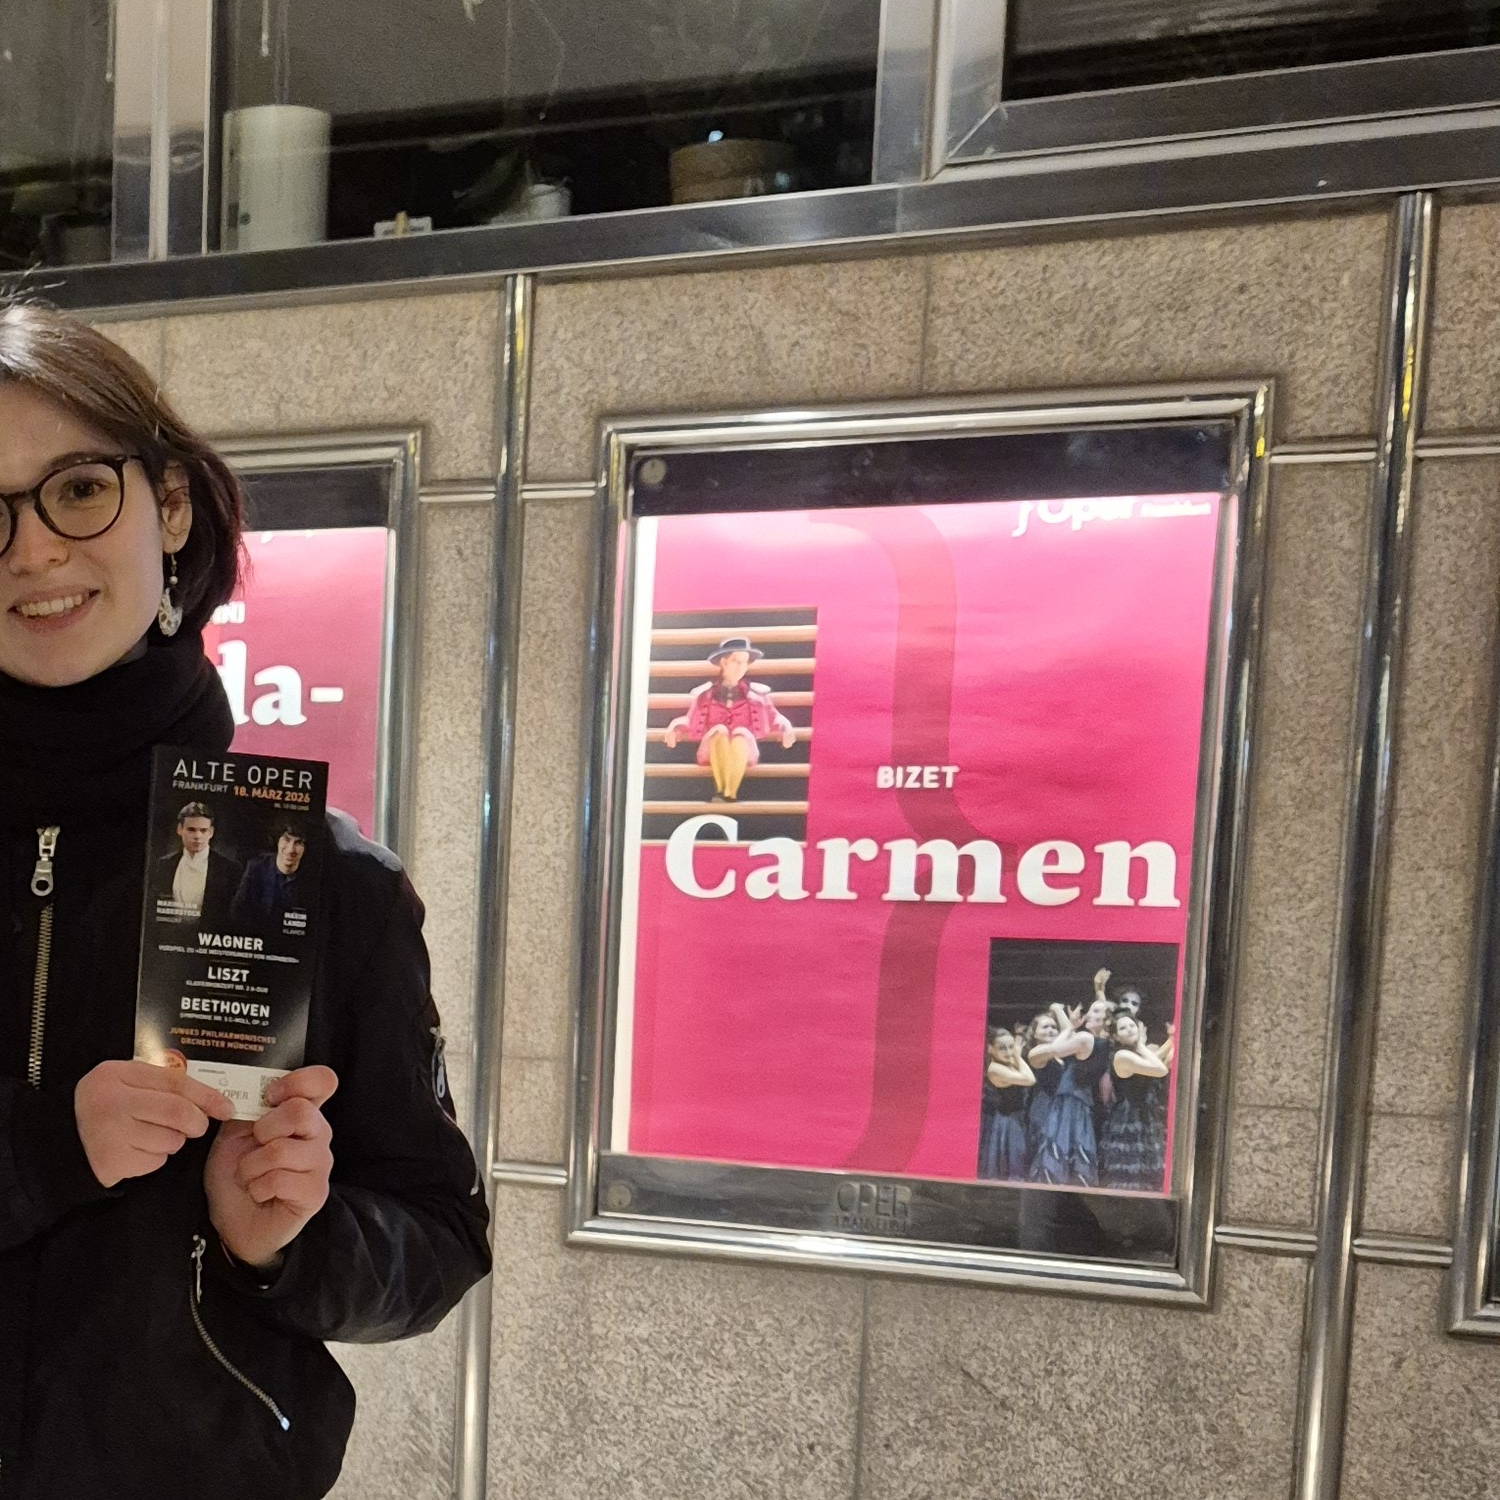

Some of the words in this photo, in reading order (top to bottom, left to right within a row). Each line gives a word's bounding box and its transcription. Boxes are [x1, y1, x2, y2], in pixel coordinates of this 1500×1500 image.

[173, 759, 236, 782] ALTE
[247, 766, 313, 790] OPER
[876, 765, 960, 791] BIZET
[172, 780, 229, 793] FRANKFURT
[234, 785, 249, 798] 18.
[252, 787, 283, 801] MÄRZ
[284, 791, 310, 803] 2026
[664, 814, 1182, 909] Carmen
[198, 932, 264, 951] WAGNER
[207, 966, 250, 982] LISZT
[181, 996, 270, 1018] BEETHOVEN
[170, 1027, 200, 1036] JUNGES
[201, 1029, 277, 1044] PHILHARMONISCHES
[181, 1037, 226, 1048] ORCHESTER
[227, 1041, 265, 1052] MÜNCHEN
